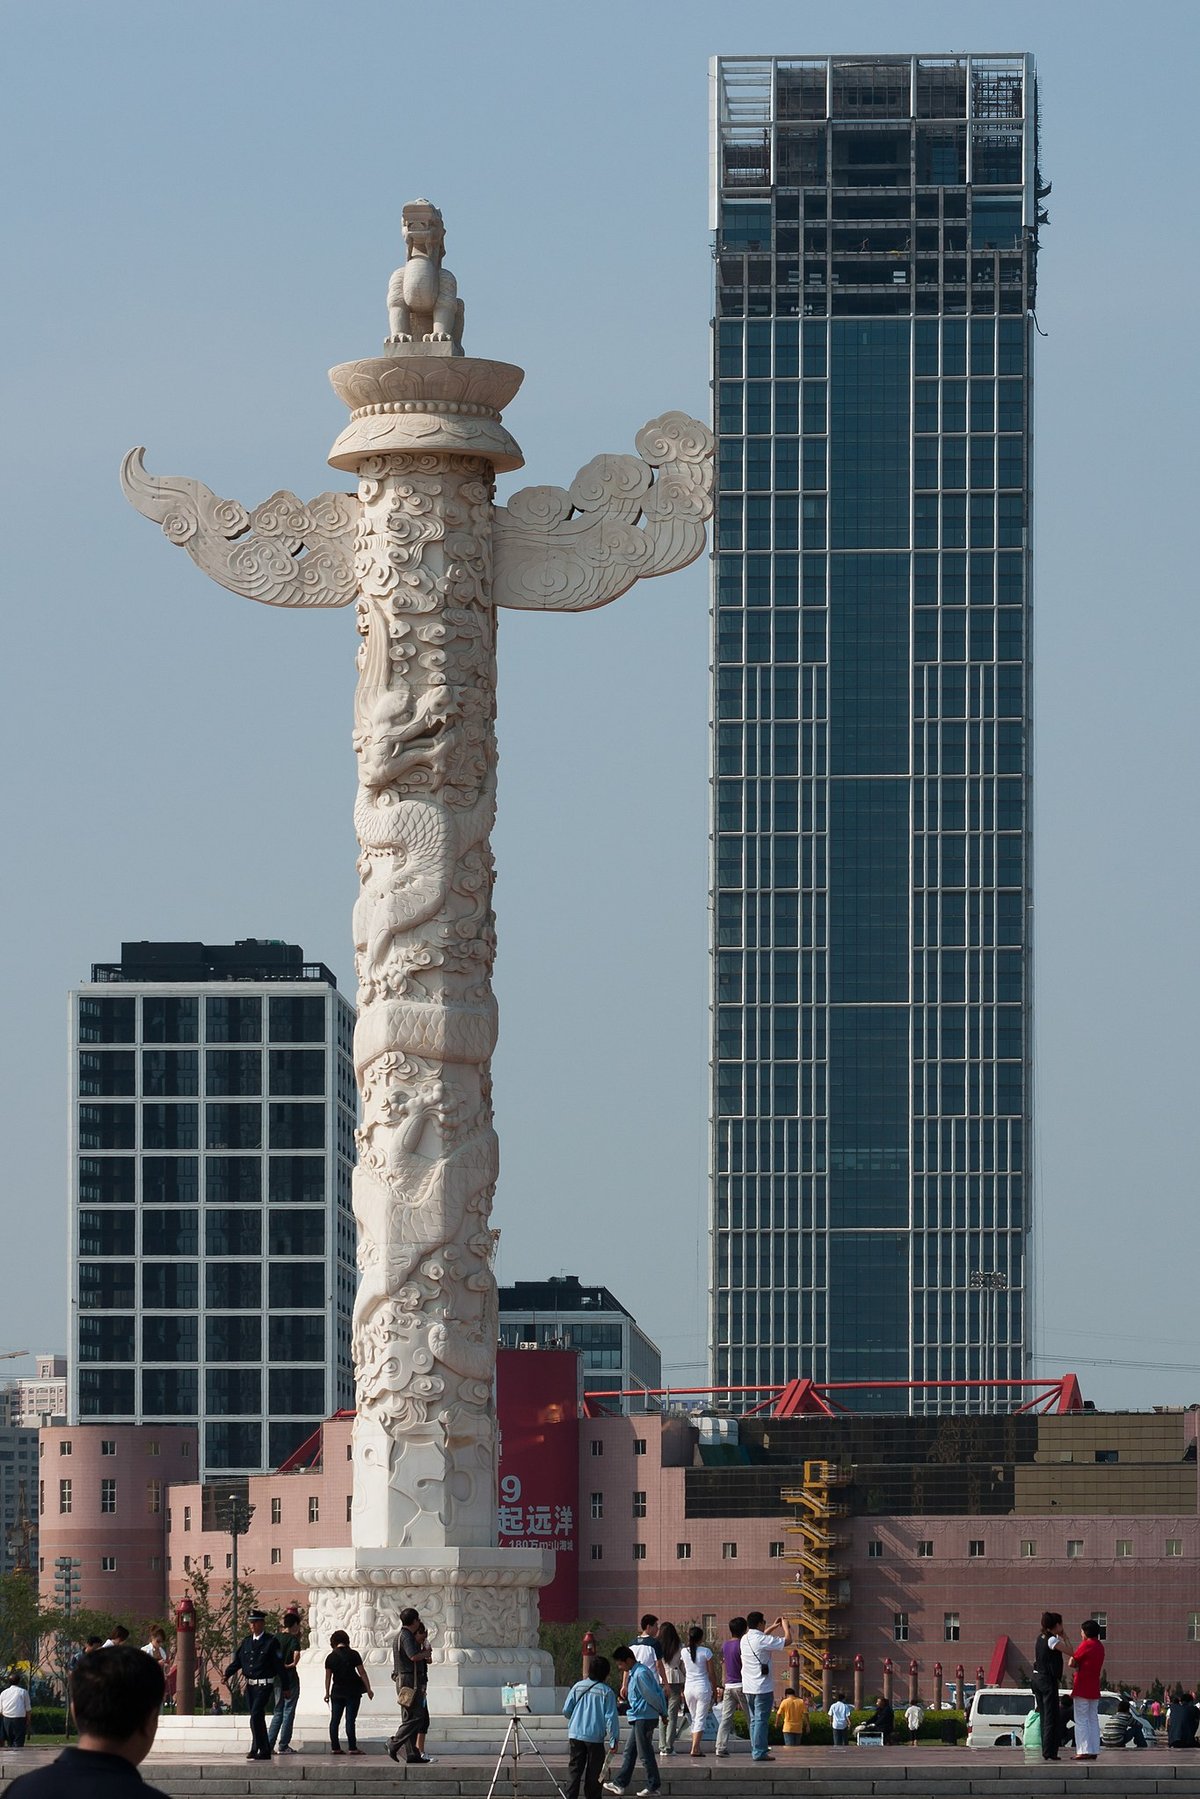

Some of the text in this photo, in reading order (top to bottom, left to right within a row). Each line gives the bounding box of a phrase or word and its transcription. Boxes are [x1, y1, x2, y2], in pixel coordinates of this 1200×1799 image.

[501, 1475, 521, 1502] 9
[497, 1505, 573, 1536] 起远洋
